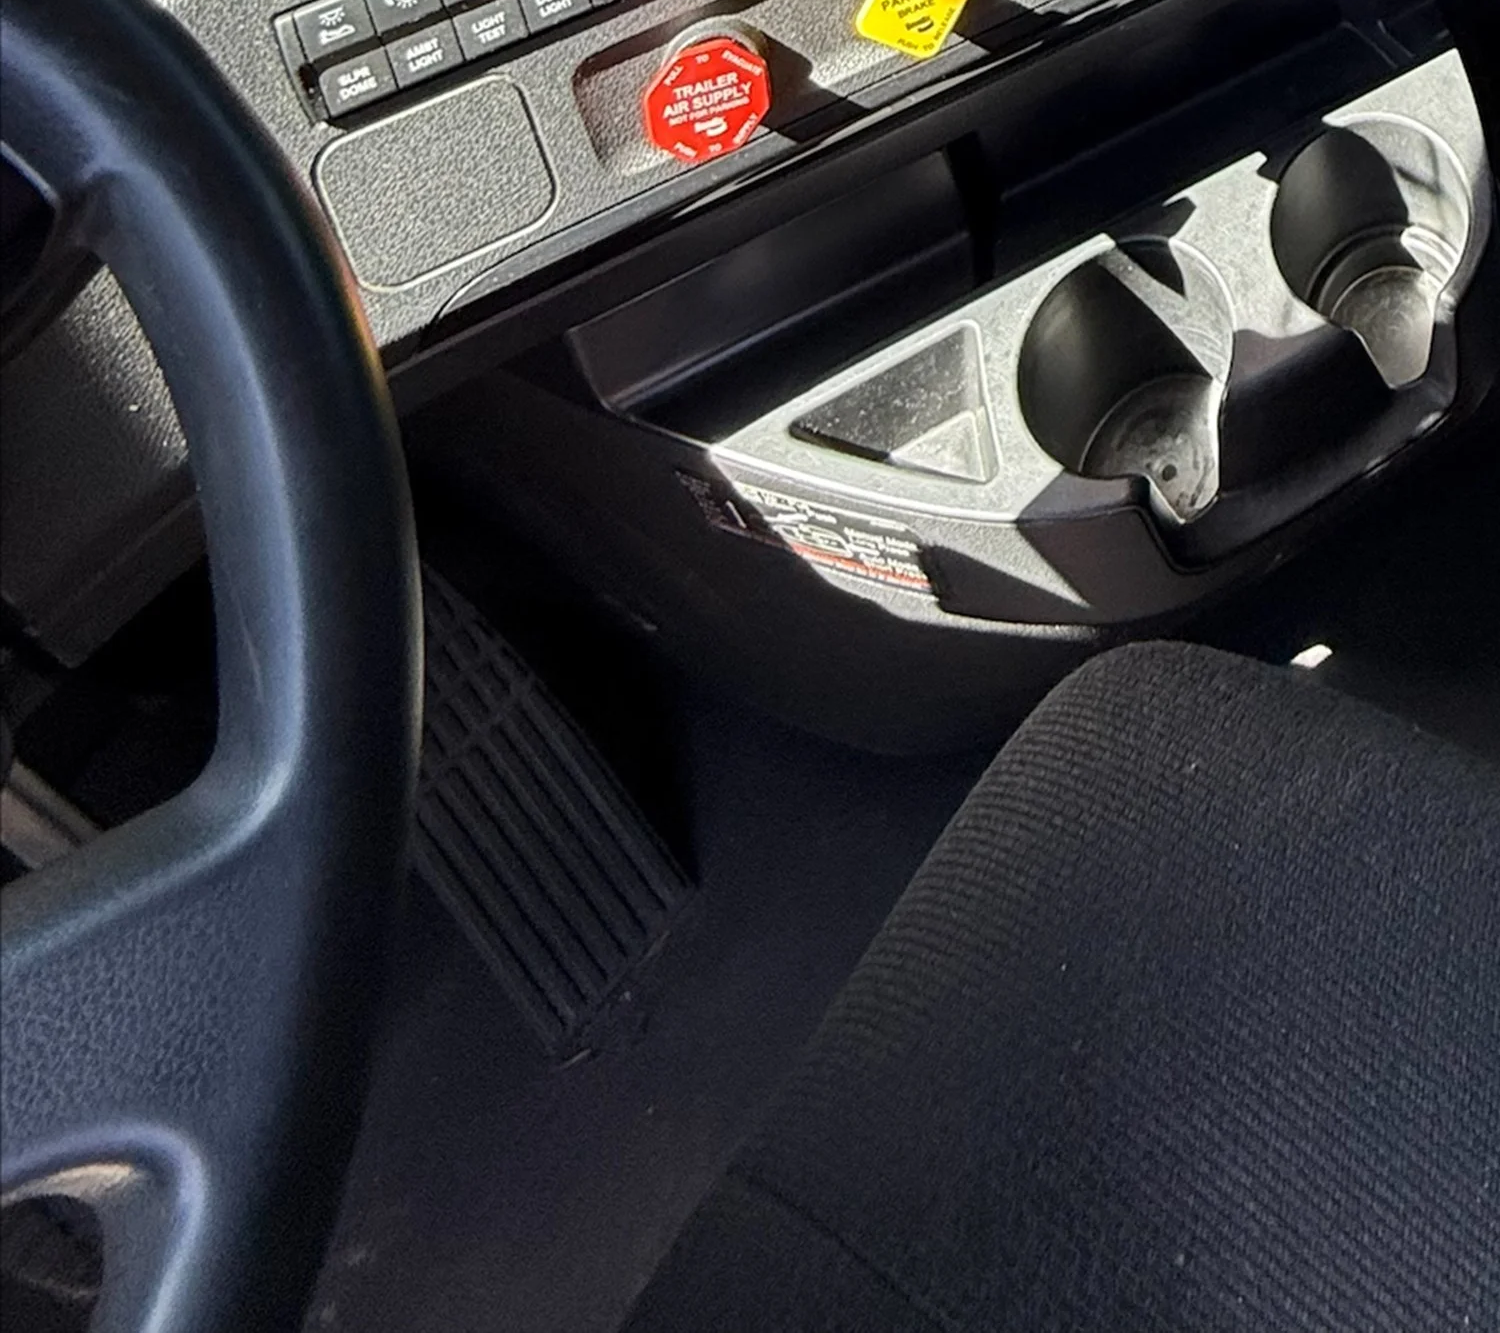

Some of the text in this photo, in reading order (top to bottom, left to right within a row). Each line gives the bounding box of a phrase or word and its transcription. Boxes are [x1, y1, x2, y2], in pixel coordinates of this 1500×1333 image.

[471, 11, 506, 34] LIGHT
[477, 27, 506, 44] TEST
[408, 49, 444, 73] LIGHT
[339, 77, 378, 101] DOME
[672, 72, 738, 100] TRAILER
[662, 81, 752, 119] AIR SUPPLY
